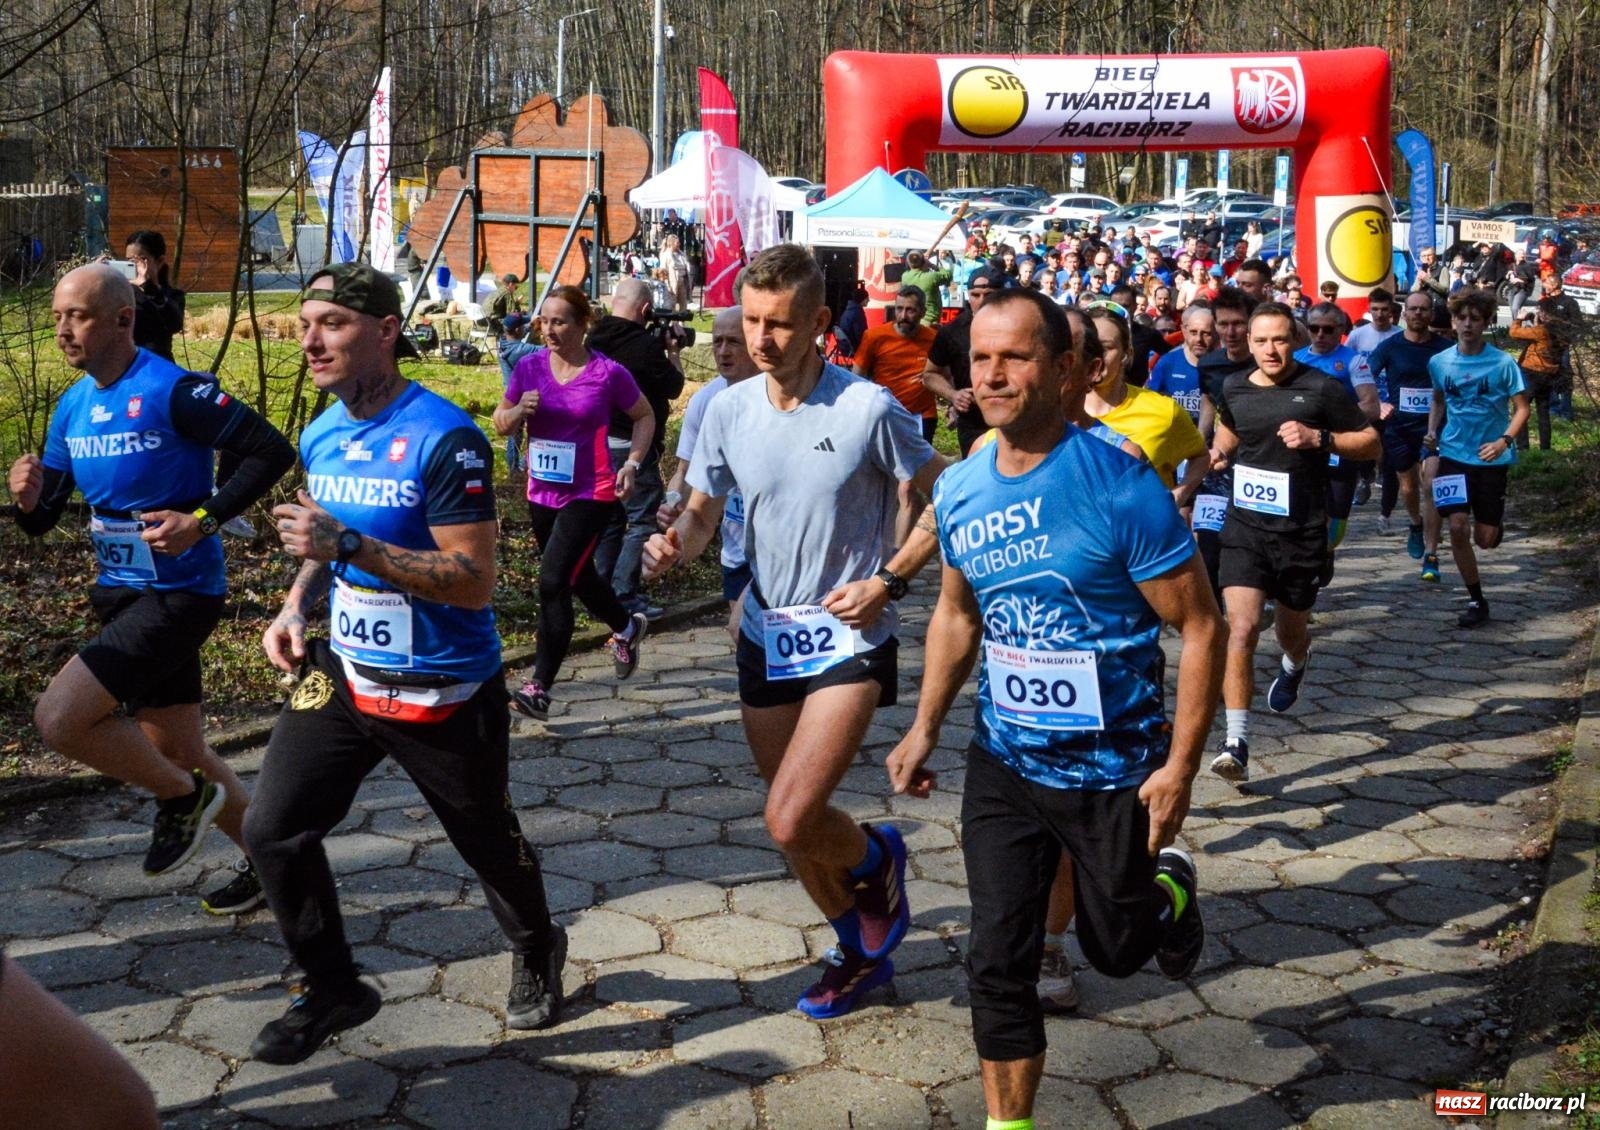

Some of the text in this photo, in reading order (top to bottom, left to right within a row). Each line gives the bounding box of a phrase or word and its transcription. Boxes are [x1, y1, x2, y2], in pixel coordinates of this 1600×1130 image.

[1095, 67, 1156, 82] BIEG
[1045, 91, 1211, 111] TWARDZIELA
[1059, 117, 1193, 139] RACIBÓRZ
[1471, 222, 1503, 232] VAMOS
[1406, 396, 1429, 406] 104
[537, 453, 558, 471] 111
[1243, 482, 1277, 502] 029
[1436, 485, 1458, 498] 007
[1201, 506, 1226, 522] 123
[949, 496, 1042, 559] MORSY
[98, 540, 134, 566] 067
[960, 534, 1053, 581] ACIBÓRZ
[338, 610, 392, 647] 046
[776, 626, 836, 658] 082
[1029, 656, 1086, 665] TWARDZIELA
[1005, 674, 1077, 708] 030
